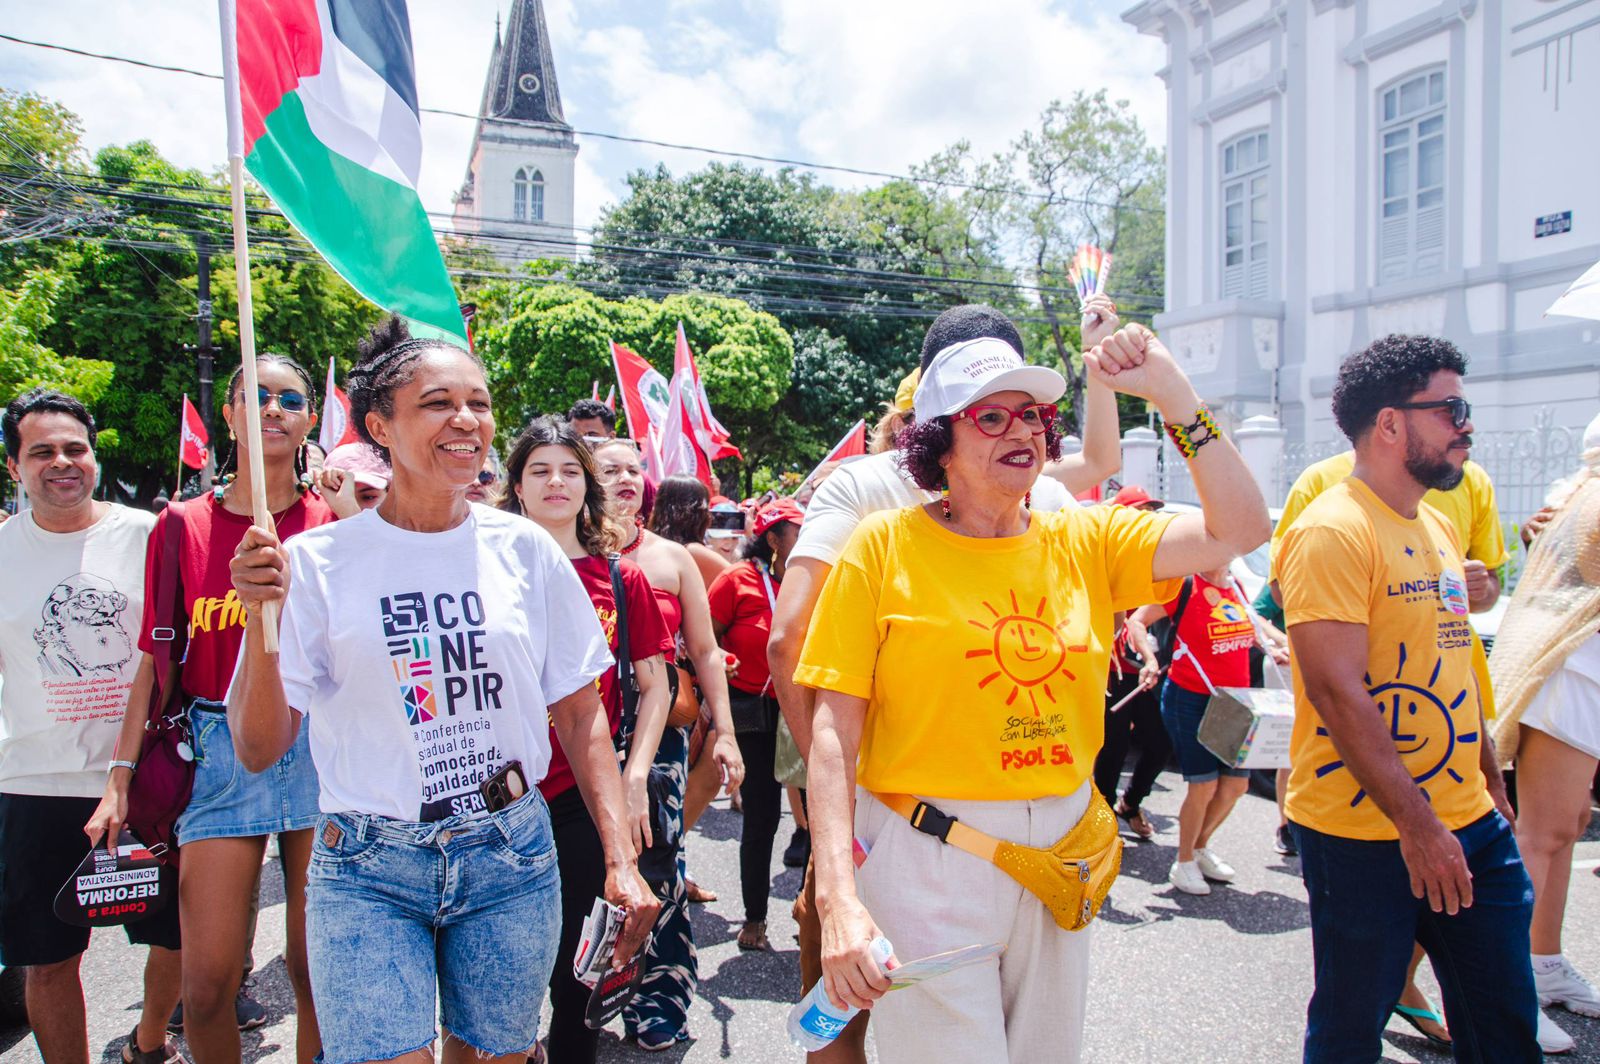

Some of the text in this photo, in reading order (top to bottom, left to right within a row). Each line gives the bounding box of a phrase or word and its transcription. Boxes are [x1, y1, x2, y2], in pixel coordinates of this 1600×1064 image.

[970, 355, 1001, 369] BRASIL
[433, 591, 486, 629] CO
[439, 630, 488, 673] NE
[444, 672, 504, 717] PIR
[460, 736, 476, 750] de
[1000, 730, 1020, 742] COM
[79, 870, 157, 887] ADMINISTRATIVA
[77, 882, 159, 906] REFORMA
[88, 902, 147, 918] Contra a
